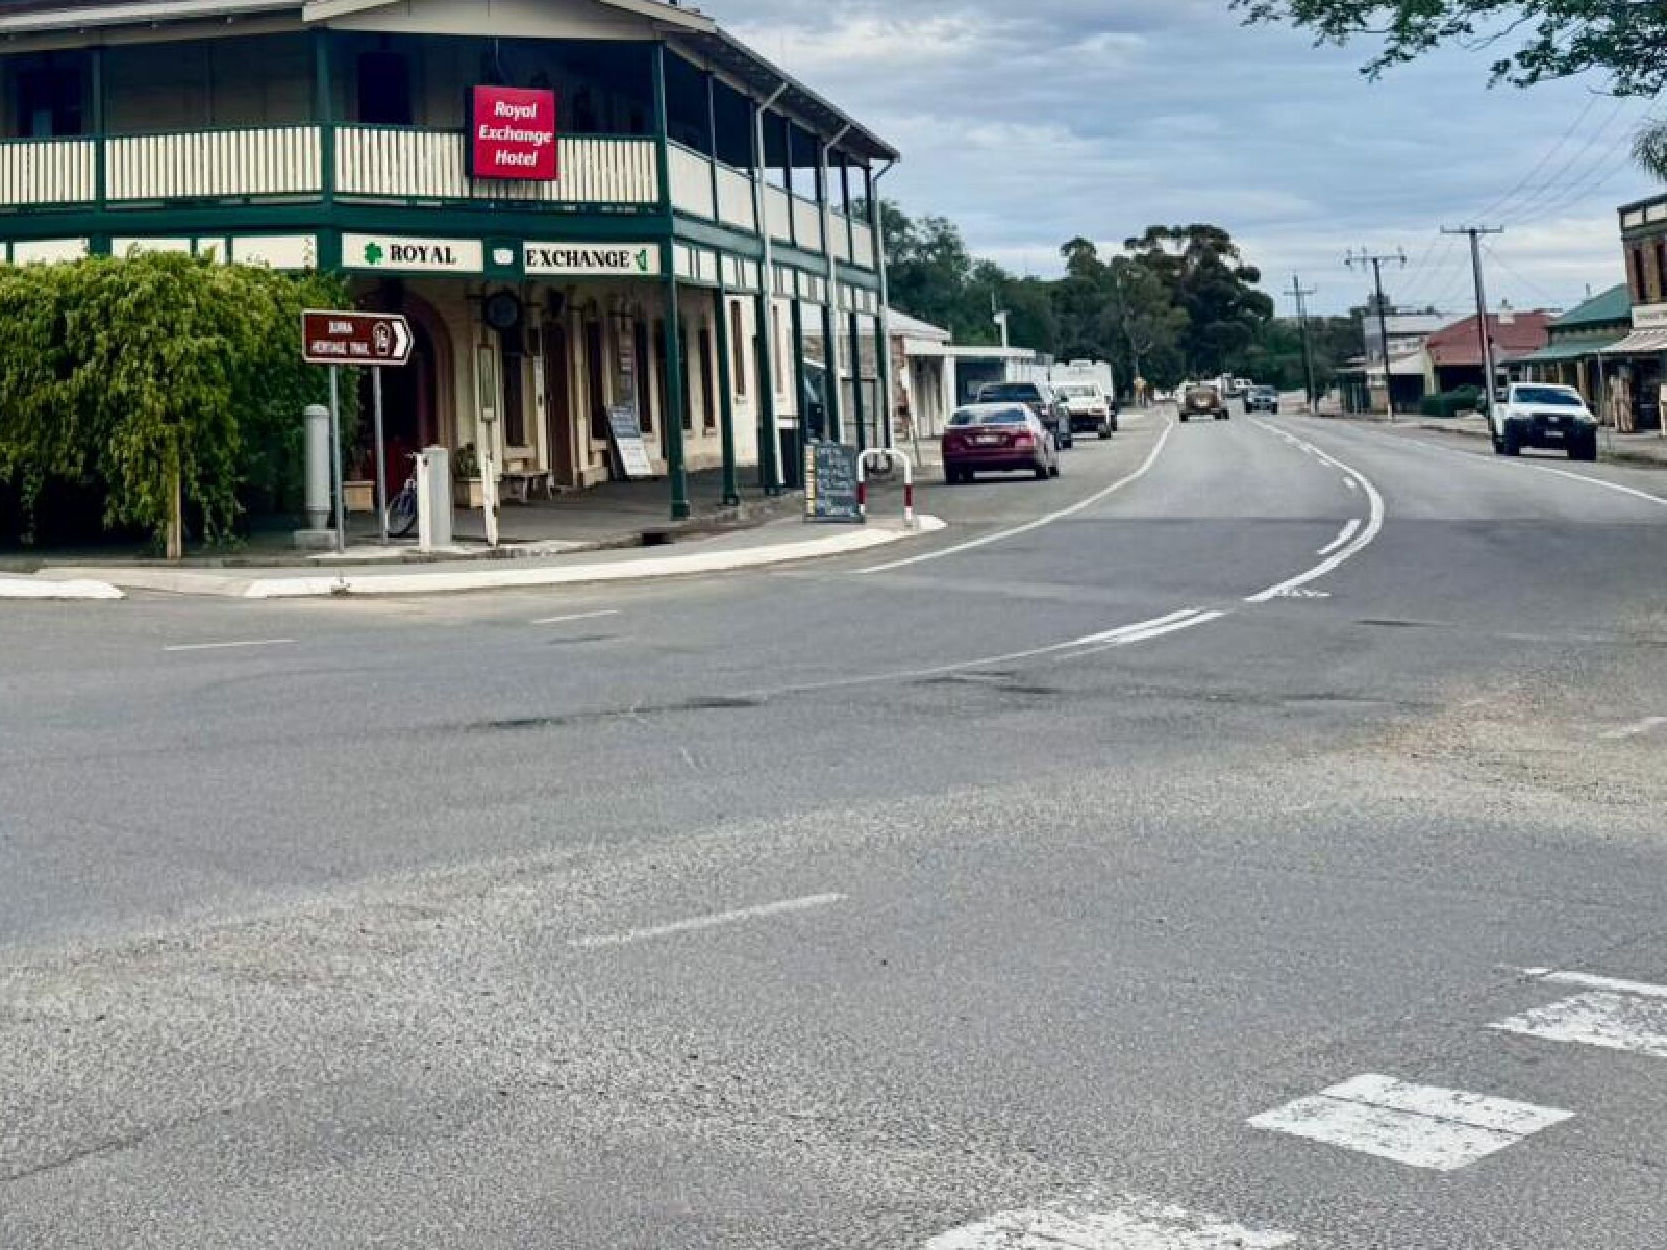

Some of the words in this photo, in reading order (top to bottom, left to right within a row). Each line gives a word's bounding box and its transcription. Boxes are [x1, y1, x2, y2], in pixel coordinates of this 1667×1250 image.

[494, 100, 538, 121] Royal
[478, 124, 552, 147] Exchange
[495, 149, 538, 167] Hotel
[389, 243, 457, 265] ROYAL
[525, 249, 630, 268] EXCHANGE
